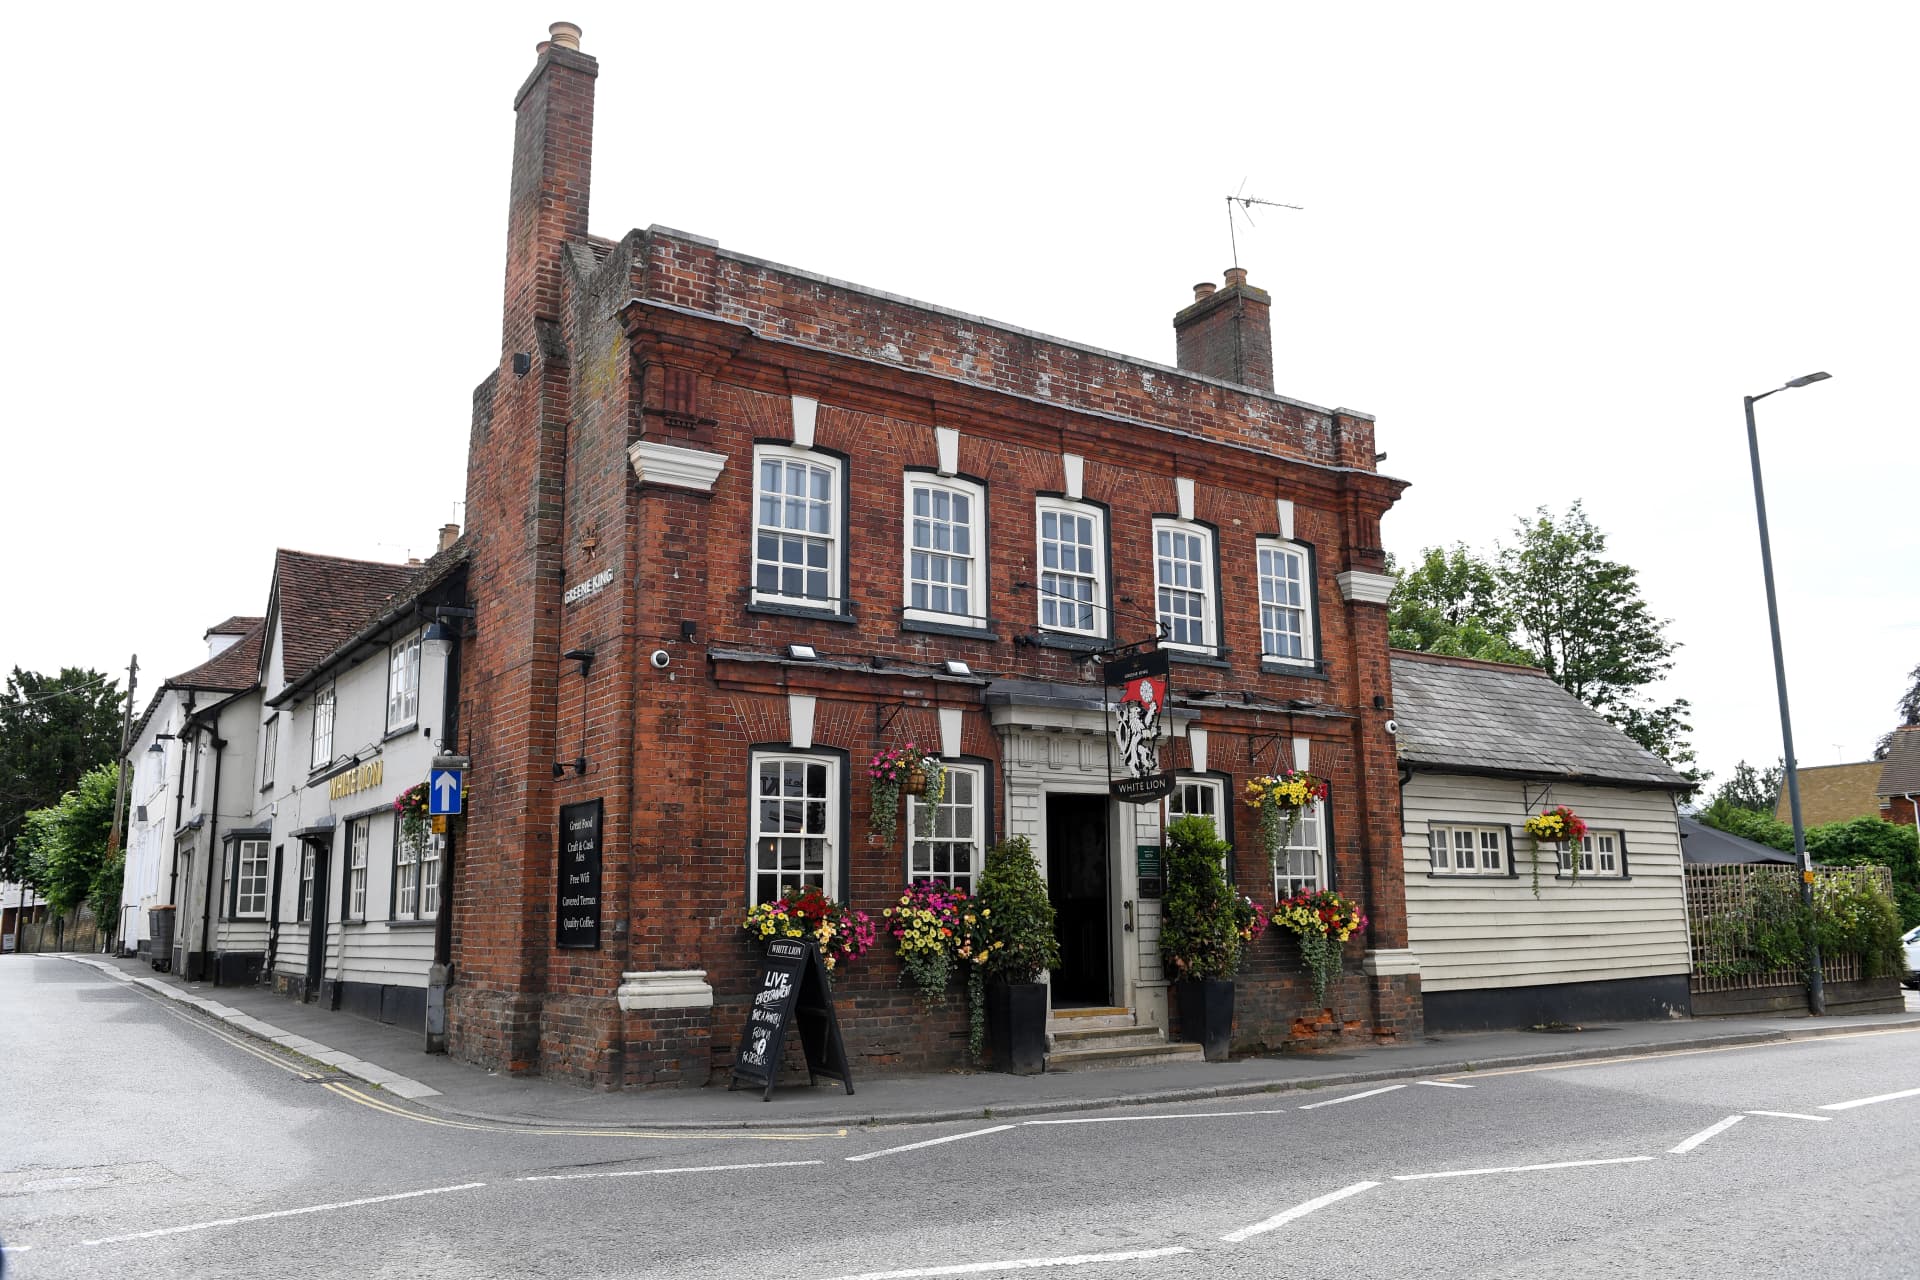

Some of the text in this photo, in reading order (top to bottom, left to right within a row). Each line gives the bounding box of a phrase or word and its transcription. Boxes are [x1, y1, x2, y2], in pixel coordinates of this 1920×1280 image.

[565, 568, 614, 604] GREENE KING
[329, 760, 383, 800] WHITE LION
[1118, 779, 1166, 793] WHITE LION
[570, 816, 593, 830] Great Food
[570, 874, 580, 884] Free
[562, 895, 579, 906] Covered
[564, 916, 594, 930] Quality Coffee
[771, 944, 802, 955] WHITE LION
[764, 971, 790, 988] LIVE
